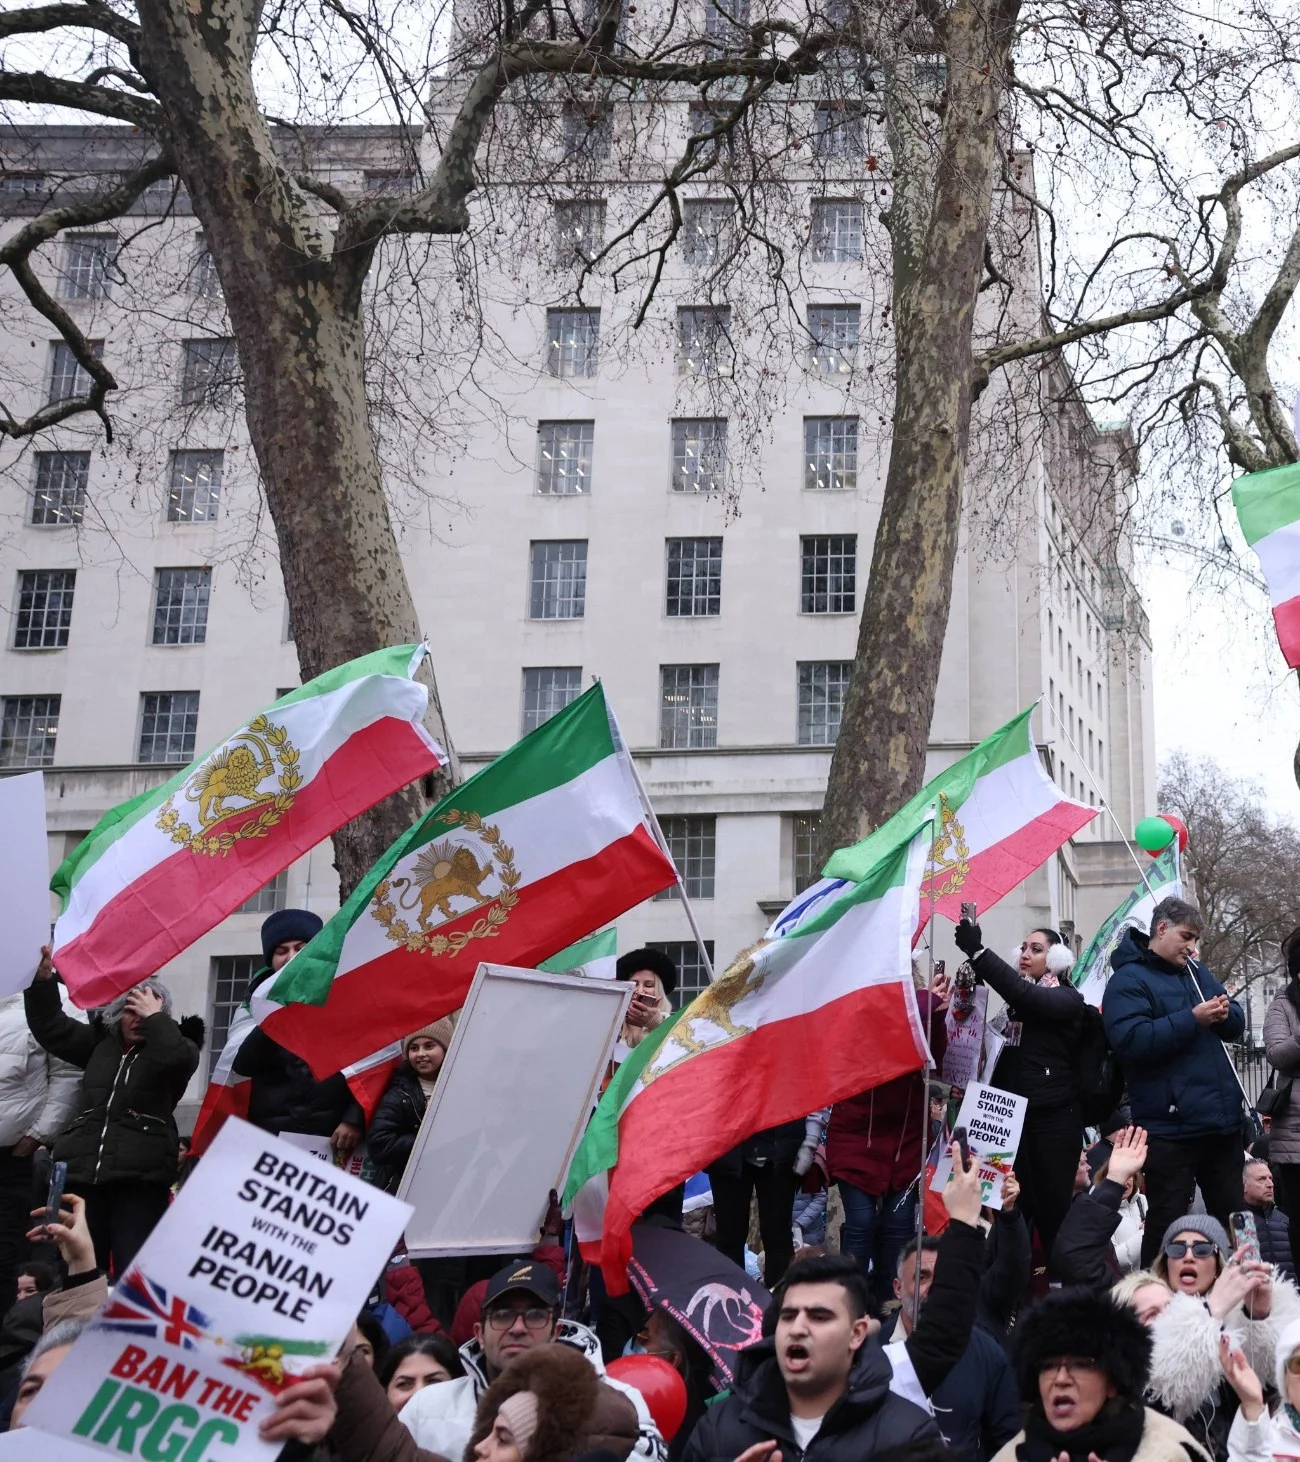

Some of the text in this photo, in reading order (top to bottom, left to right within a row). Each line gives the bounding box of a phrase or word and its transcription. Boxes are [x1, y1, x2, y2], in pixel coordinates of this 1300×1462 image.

[977, 1101, 1013, 1118] STANDS
[979, 1090, 1016, 1108] BRITAIN
[983, 1113, 995, 1121] WITH
[968, 1130, 1006, 1147] PEOPLE
[970, 1119, 1011, 1138] IRANIAN
[253, 1151, 369, 1222] BRITAIN
[977, 1168, 997, 1183] THE
[237, 1179, 356, 1246] STANDS
[251, 1216, 318, 1256] WITH THE
[201, 1225, 334, 1299] IRANIAN
[188, 1256, 314, 1323] PEOPLE
[109, 1344, 262, 1424] BAN THE
[71, 1378, 239, 1462] IRGC
